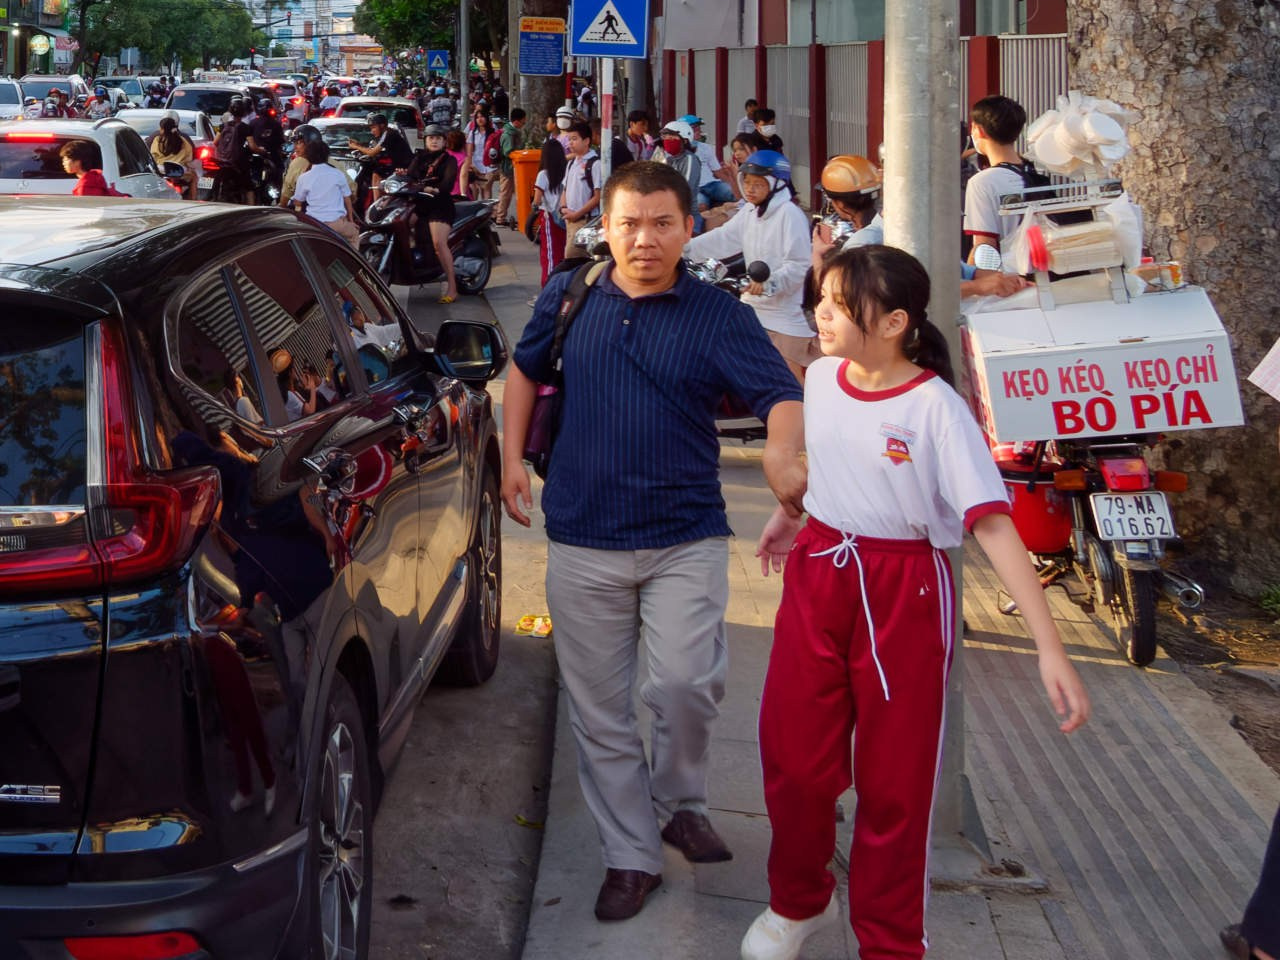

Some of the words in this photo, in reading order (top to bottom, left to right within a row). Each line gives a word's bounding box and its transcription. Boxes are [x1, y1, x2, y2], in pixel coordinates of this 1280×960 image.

[1002, 367, 1048, 400] KẸO
[1057, 358, 1105, 394] KÉO
[1124, 358, 1171, 392] KẸO
[1176, 343, 1218, 384] CHỈ
[1052, 390, 1117, 436] BÒ
[1130, 383, 1213, 430] PÍA
[1104, 496, 1157, 516] 79-NA
[1103, 517, 1169, 537] 016.62
